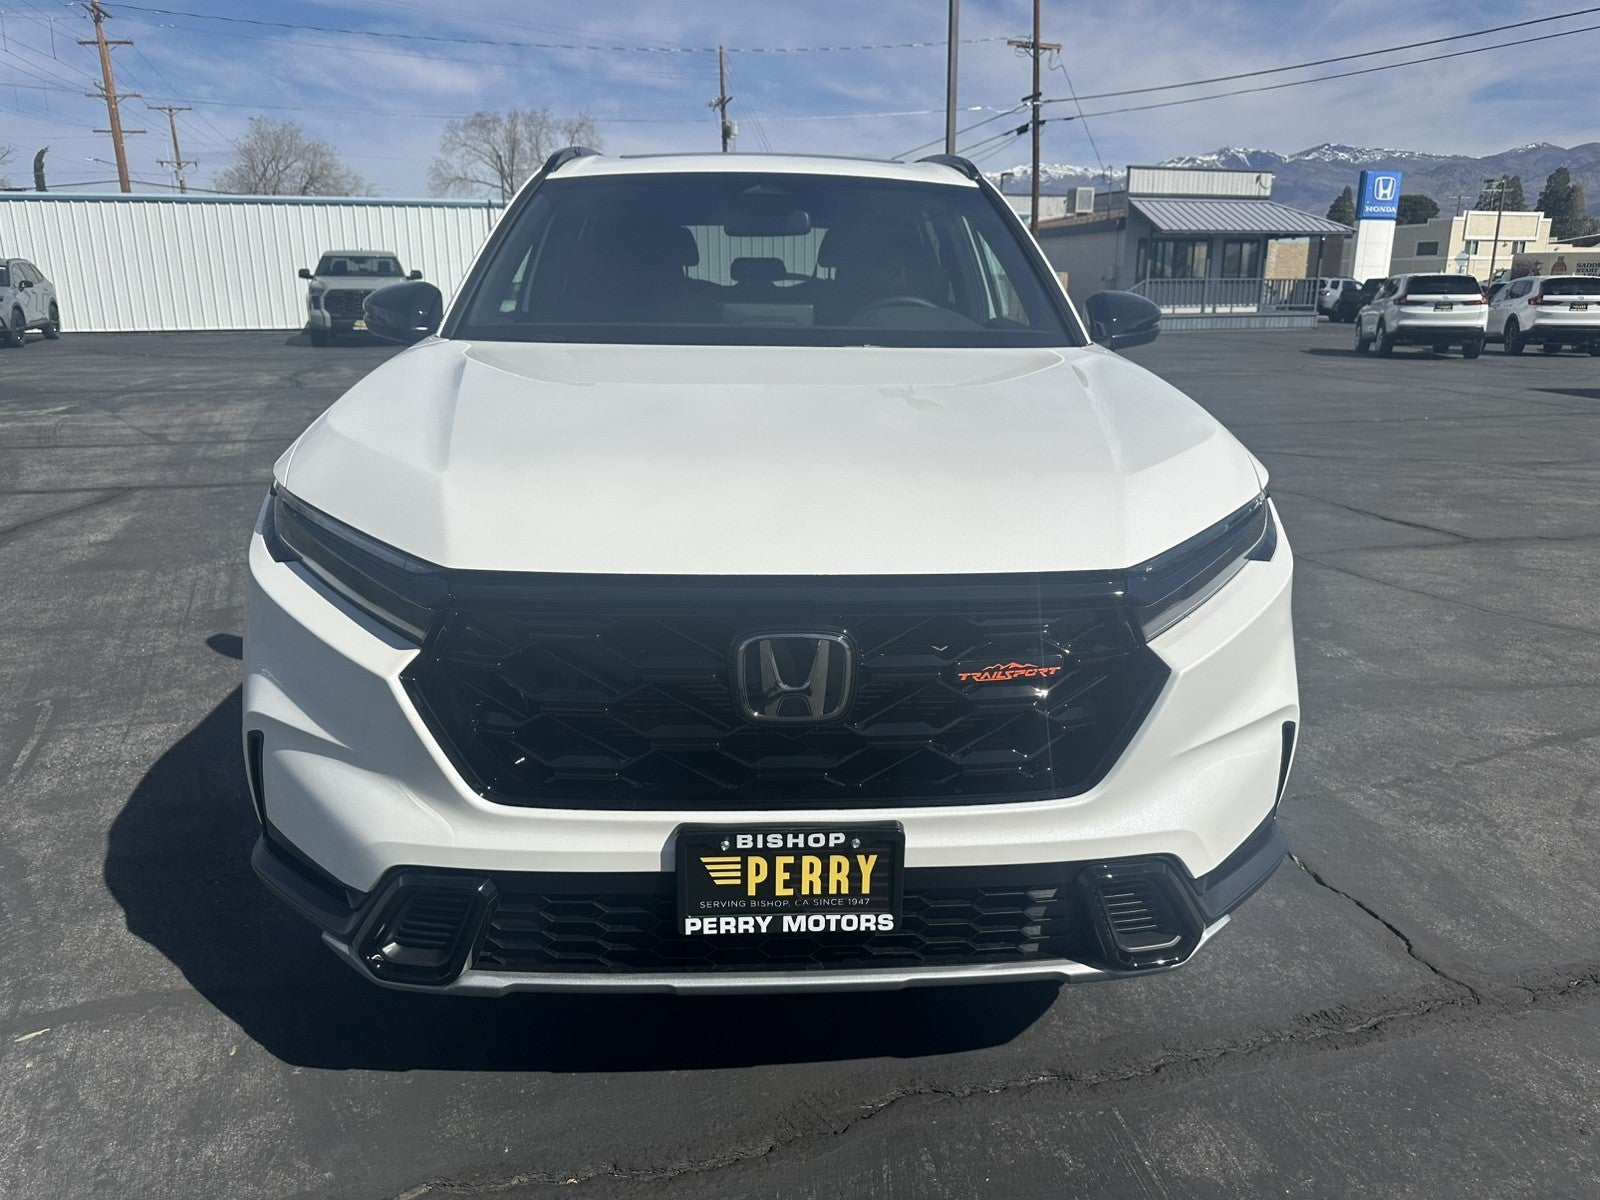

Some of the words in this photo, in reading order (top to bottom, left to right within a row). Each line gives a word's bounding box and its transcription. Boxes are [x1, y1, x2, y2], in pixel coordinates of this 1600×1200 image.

[958, 666, 1061, 682] TRAILSPORT
[736, 833, 846, 849] BISHOP
[747, 854, 878, 896] PERRY
[699, 900, 747, 909] SERVING
[750, 900, 791, 908] BISHOP,
[813, 898, 845, 906] SINCE
[847, 897, 870, 906] 1947
[685, 917, 773, 935] PERRY
[782, 914, 894, 933] MOTORS
